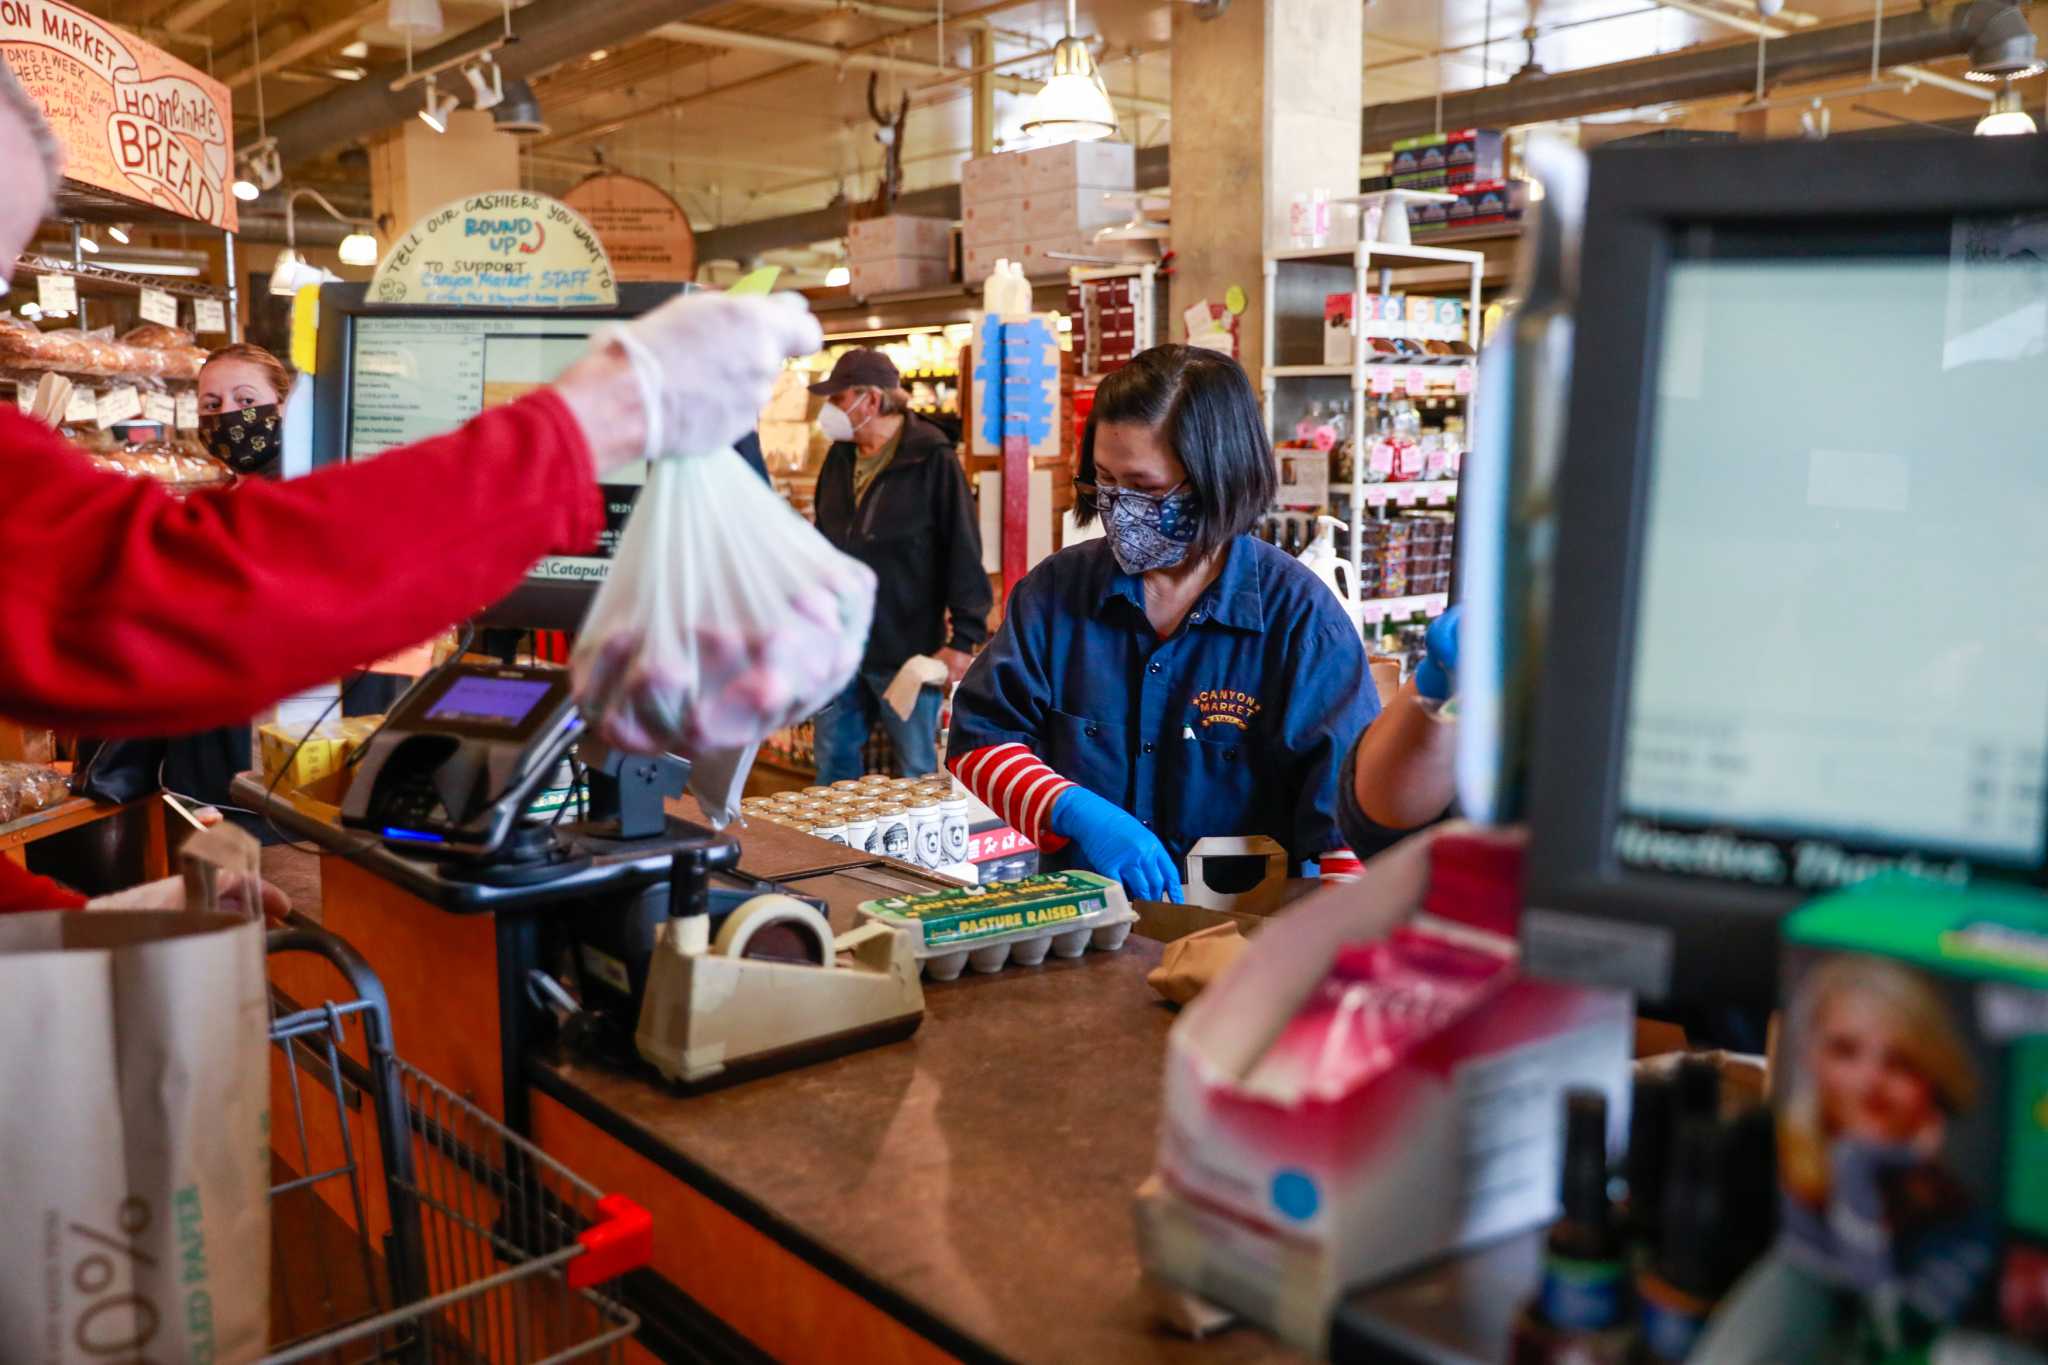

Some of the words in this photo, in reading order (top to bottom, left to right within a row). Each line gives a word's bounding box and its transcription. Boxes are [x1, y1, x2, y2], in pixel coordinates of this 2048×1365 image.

[42, 9, 117, 70] MARKET
[8, 49, 36, 63] DAYS
[41, 51, 48, 63] A
[52, 54, 85, 82] WEEK
[117, 119, 214, 224] BREAD
[464, 217, 533, 237] ROUND
[387, 234, 424, 273] TELL
[427, 209, 460, 233] OUR
[464, 195, 540, 213] CASHIERS
[547, 205, 573, 225] YOU
[573, 222, 604, 264] WANT
[598, 264, 613, 289] TO
[489, 235, 518, 256] UP
[424, 261, 444, 274] TO
[453, 260, 528, 276] SUPPORT
[541, 268, 593, 288] STAFF
[1199, 689, 1256, 707] CANYON
[1200, 702, 1256, 718] MARKET
[959, 912, 1024, 933] PASTURE
[1026, 904, 1078, 923] RAISED
[172, 1185, 207, 1284] PAPER
